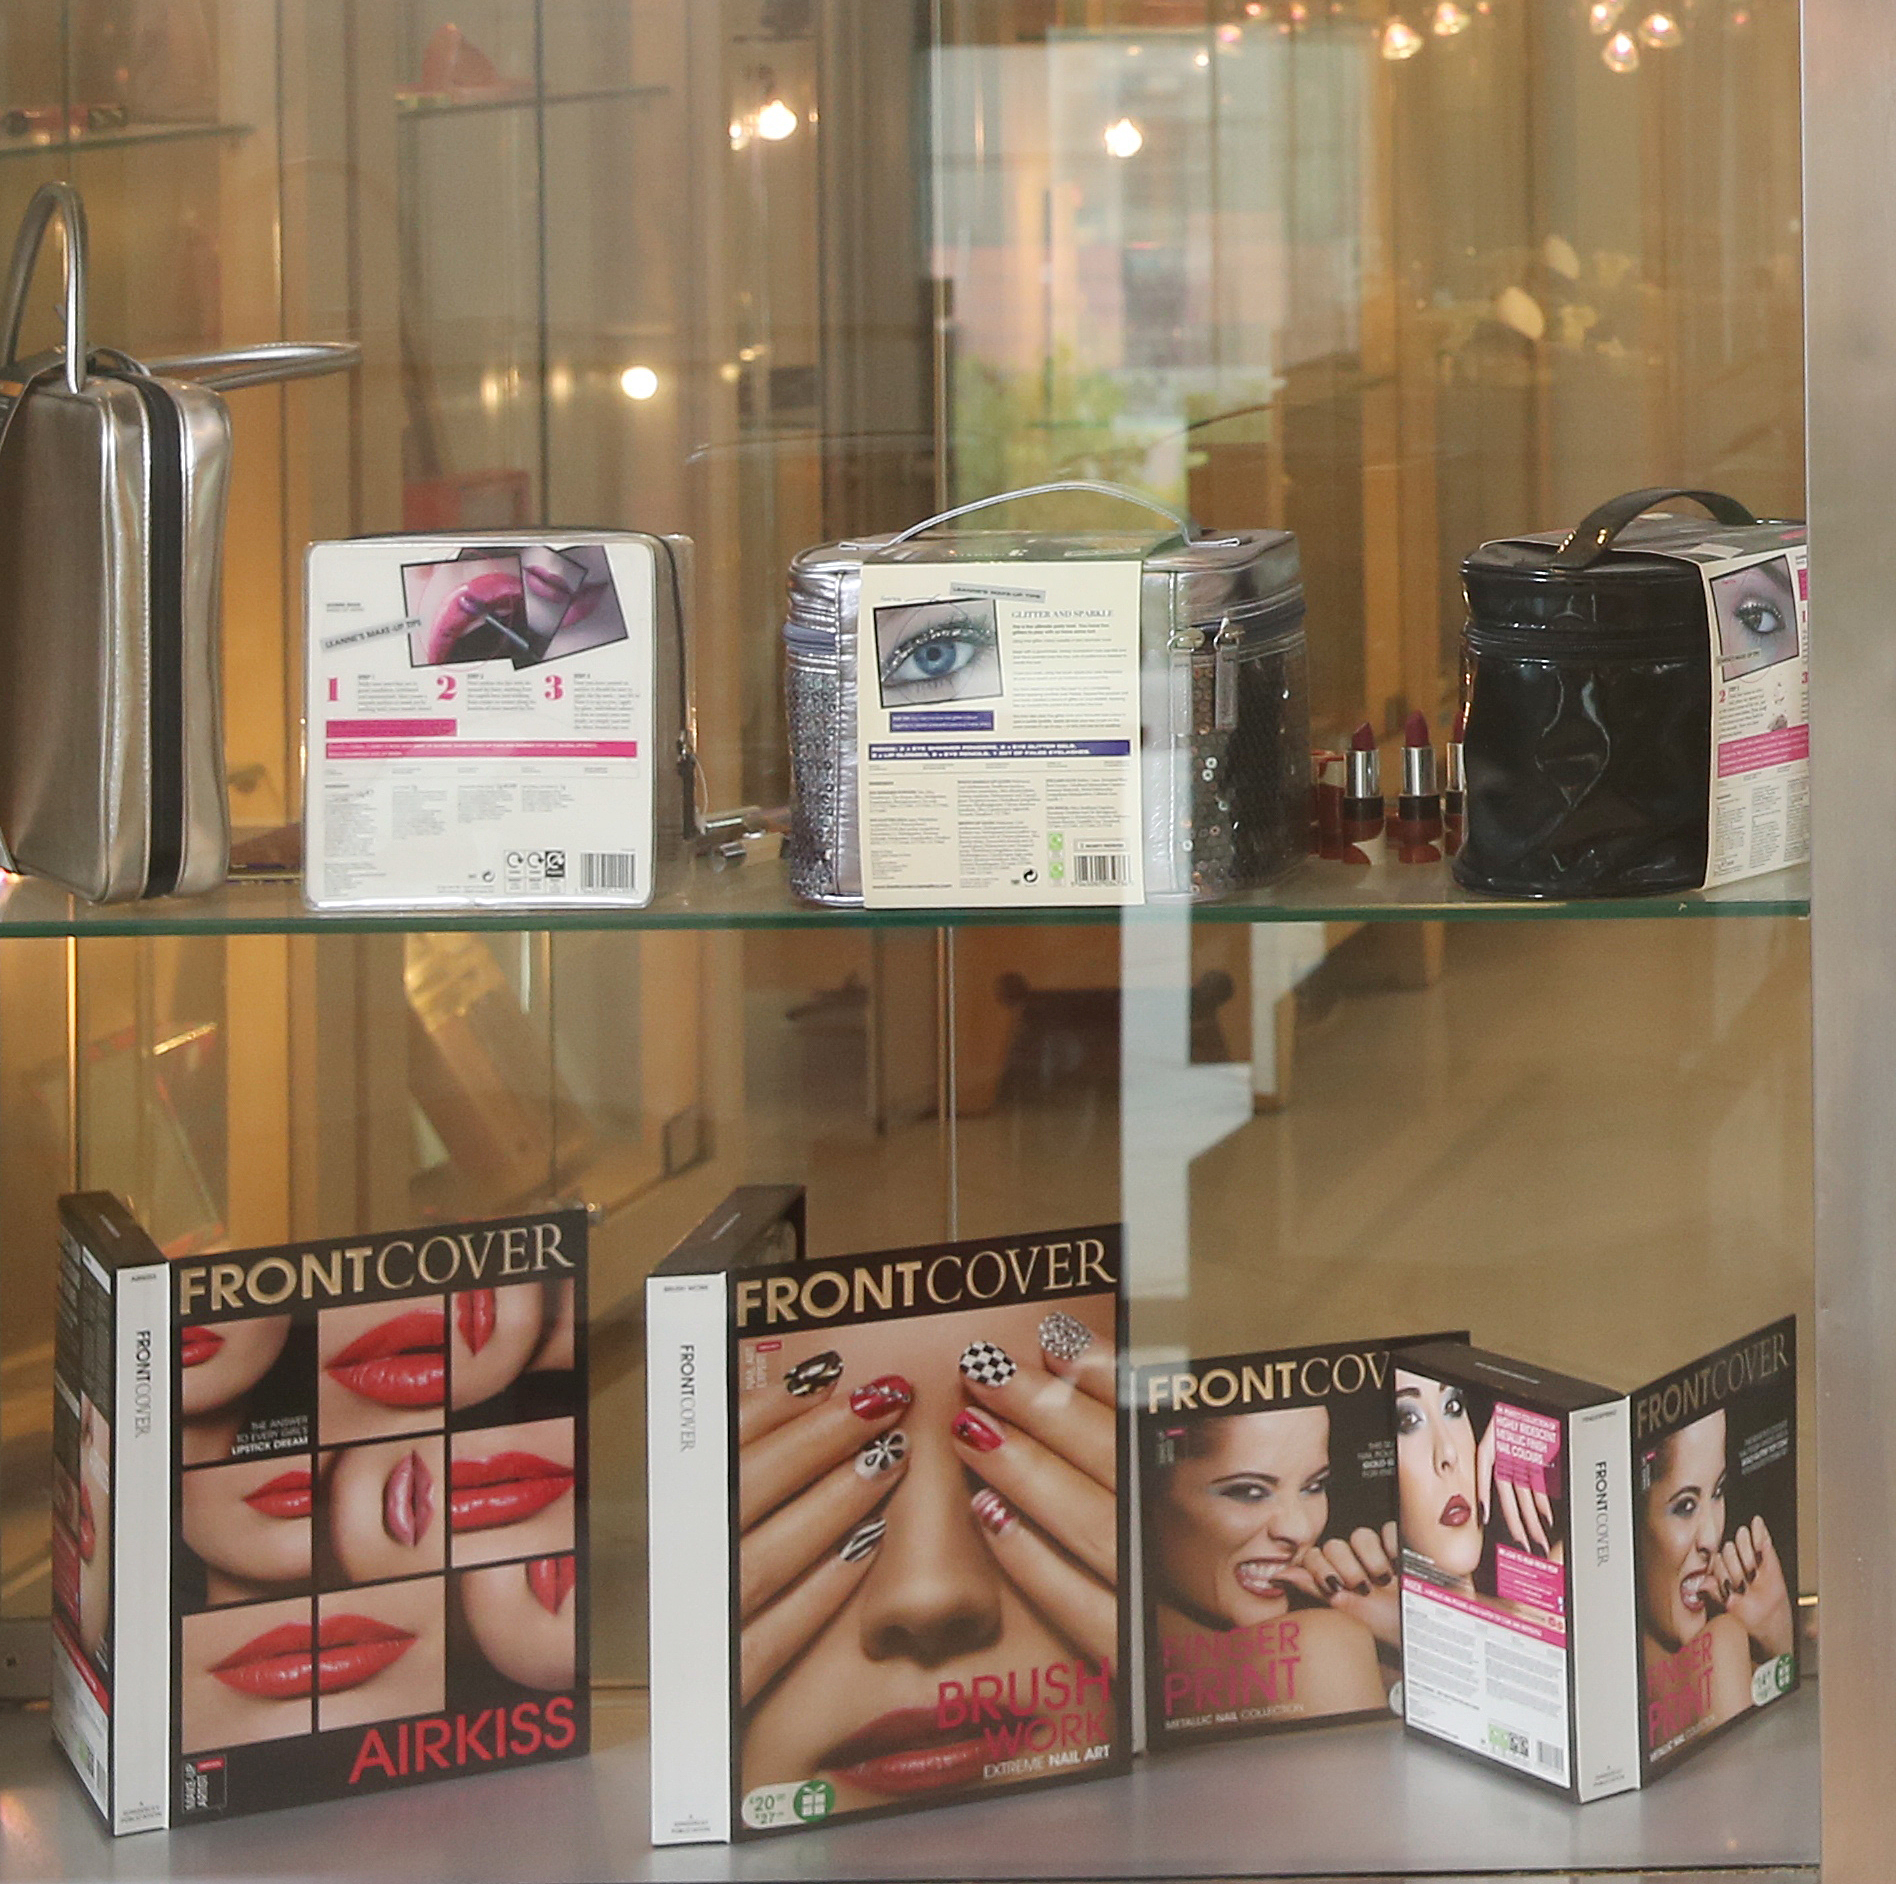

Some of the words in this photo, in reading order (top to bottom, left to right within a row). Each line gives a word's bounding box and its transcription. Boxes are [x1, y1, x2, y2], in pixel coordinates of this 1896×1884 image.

[326, 631, 364, 647] LEANNE'S
[367, 622, 404, 640] MAKE-UP
[406, 619, 422, 630] TIPS
[1012, 610, 1050, 619] GLITTER
[1053, 610, 1071, 618] AND
[1074, 609, 1114, 618] SPARKLE
[327, 678, 340, 702] 1
[436, 675, 458, 700] 2
[545, 675, 564, 701] 3
[1718, 690, 1726, 703] 2
[179, 1223, 574, 1314] FRONTCOVER
[737, 1239, 1117, 1327] FRONTCOVER
[135, 1330, 152, 1439] FRONTCOVER
[679, 1344, 696, 1451] FRONTCOVER
[1637, 1333, 1789, 1439] FRONTCOVER
[231, 1442, 271, 1455] LIPSTICK
[273, 1436, 308, 1449] DREAM
[1594, 1461, 1608, 1566] FRONTCOVER
[1163, 1621, 1300, 1668] FINGER
[1648, 1632, 1712, 1698] FINGER
[938, 1656, 1110, 1729] BRUSH
[1163, 1657, 1301, 1716] PRINT
[1648, 1667, 1714, 1747] PRINT
[349, 1697, 576, 1784] AIRKISS
[984, 1709, 1110, 1758] WORK
[1164, 1717, 1212, 1730] METALLIC
[1215, 1714, 1238, 1723] NAIL
[1241, 1703, 1304, 1718] COLLECTION
[982, 1757, 1046, 1780] EXTREME
[1050, 1751, 1077, 1767] NAIL
[1084, 1744, 1111, 1762] ART
